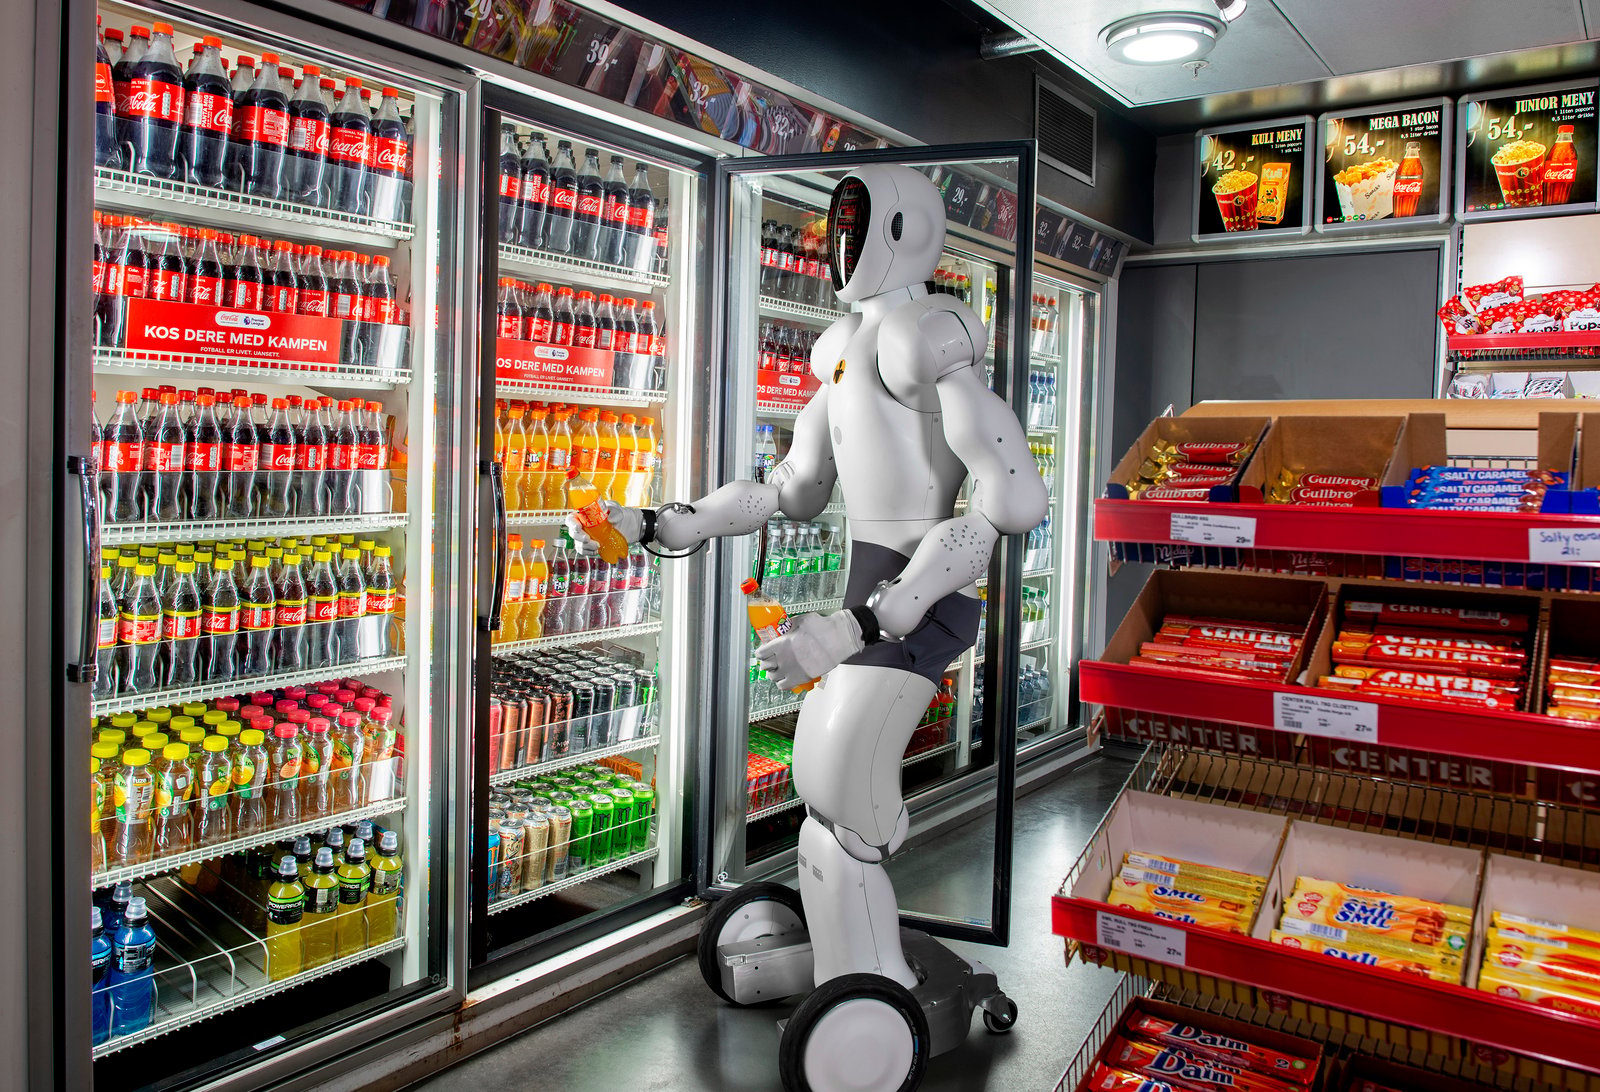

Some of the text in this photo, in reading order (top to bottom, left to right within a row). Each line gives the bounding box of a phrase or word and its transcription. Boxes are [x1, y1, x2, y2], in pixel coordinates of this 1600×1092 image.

[587, 39, 618, 72] 39,-
[690, 81, 716, 109] 32,-
[1514, 91, 1595, 116] JUNIOR MENY
[1574, 106, 1595, 114] popcorn
[1369, 110, 1440, 131] MEGA BACON
[1487, 115, 1534, 140] 54,-
[1251, 128, 1303, 146] KULI MENY
[1344, 133, 1385, 156] 54,-
[1262, 168, 1283, 179] Kuli
[144, 325, 328, 352] KOS DERE MED KAMPEN
[497, 357, 605, 378] OS DERE MED KAMPEN
[757, 384, 766, 393] OS
[767, 386, 783, 396] DERE
[783, 387, 797, 397] MED
[1183, 442, 1240, 450] Gullbrød
[1175, 463, 1234, 472] Gullbrød
[1444, 471, 1529, 480] SALTY CARAMEL
[1308, 475, 1370, 486] Gullbrød
[1438, 484, 1524, 493] SALTY CARAMEL
[1145, 488, 1205, 499] Gullbrød
[1468, 497, 1520, 505] CARAMEL
[1540, 531, 1600, 546] Salty cara
[1405, 559, 1482, 575] Stratos
[1389, 603, 1453, 615] CENTER
[1200, 627, 1291, 645] CENTER
[1381, 645, 1493, 663] CENTER
[1381, 671, 1491, 693] CENTER
[1332, 703, 1359, 711] CLOETTA
[1128, 718, 1257, 751] CENTER
[1333, 748, 1493, 786] CENTER
[1165, 1023, 1249, 1053] Daim
[1145, 1050, 1234, 1086] Daim
[1274, 1058, 1290, 1069] 2
